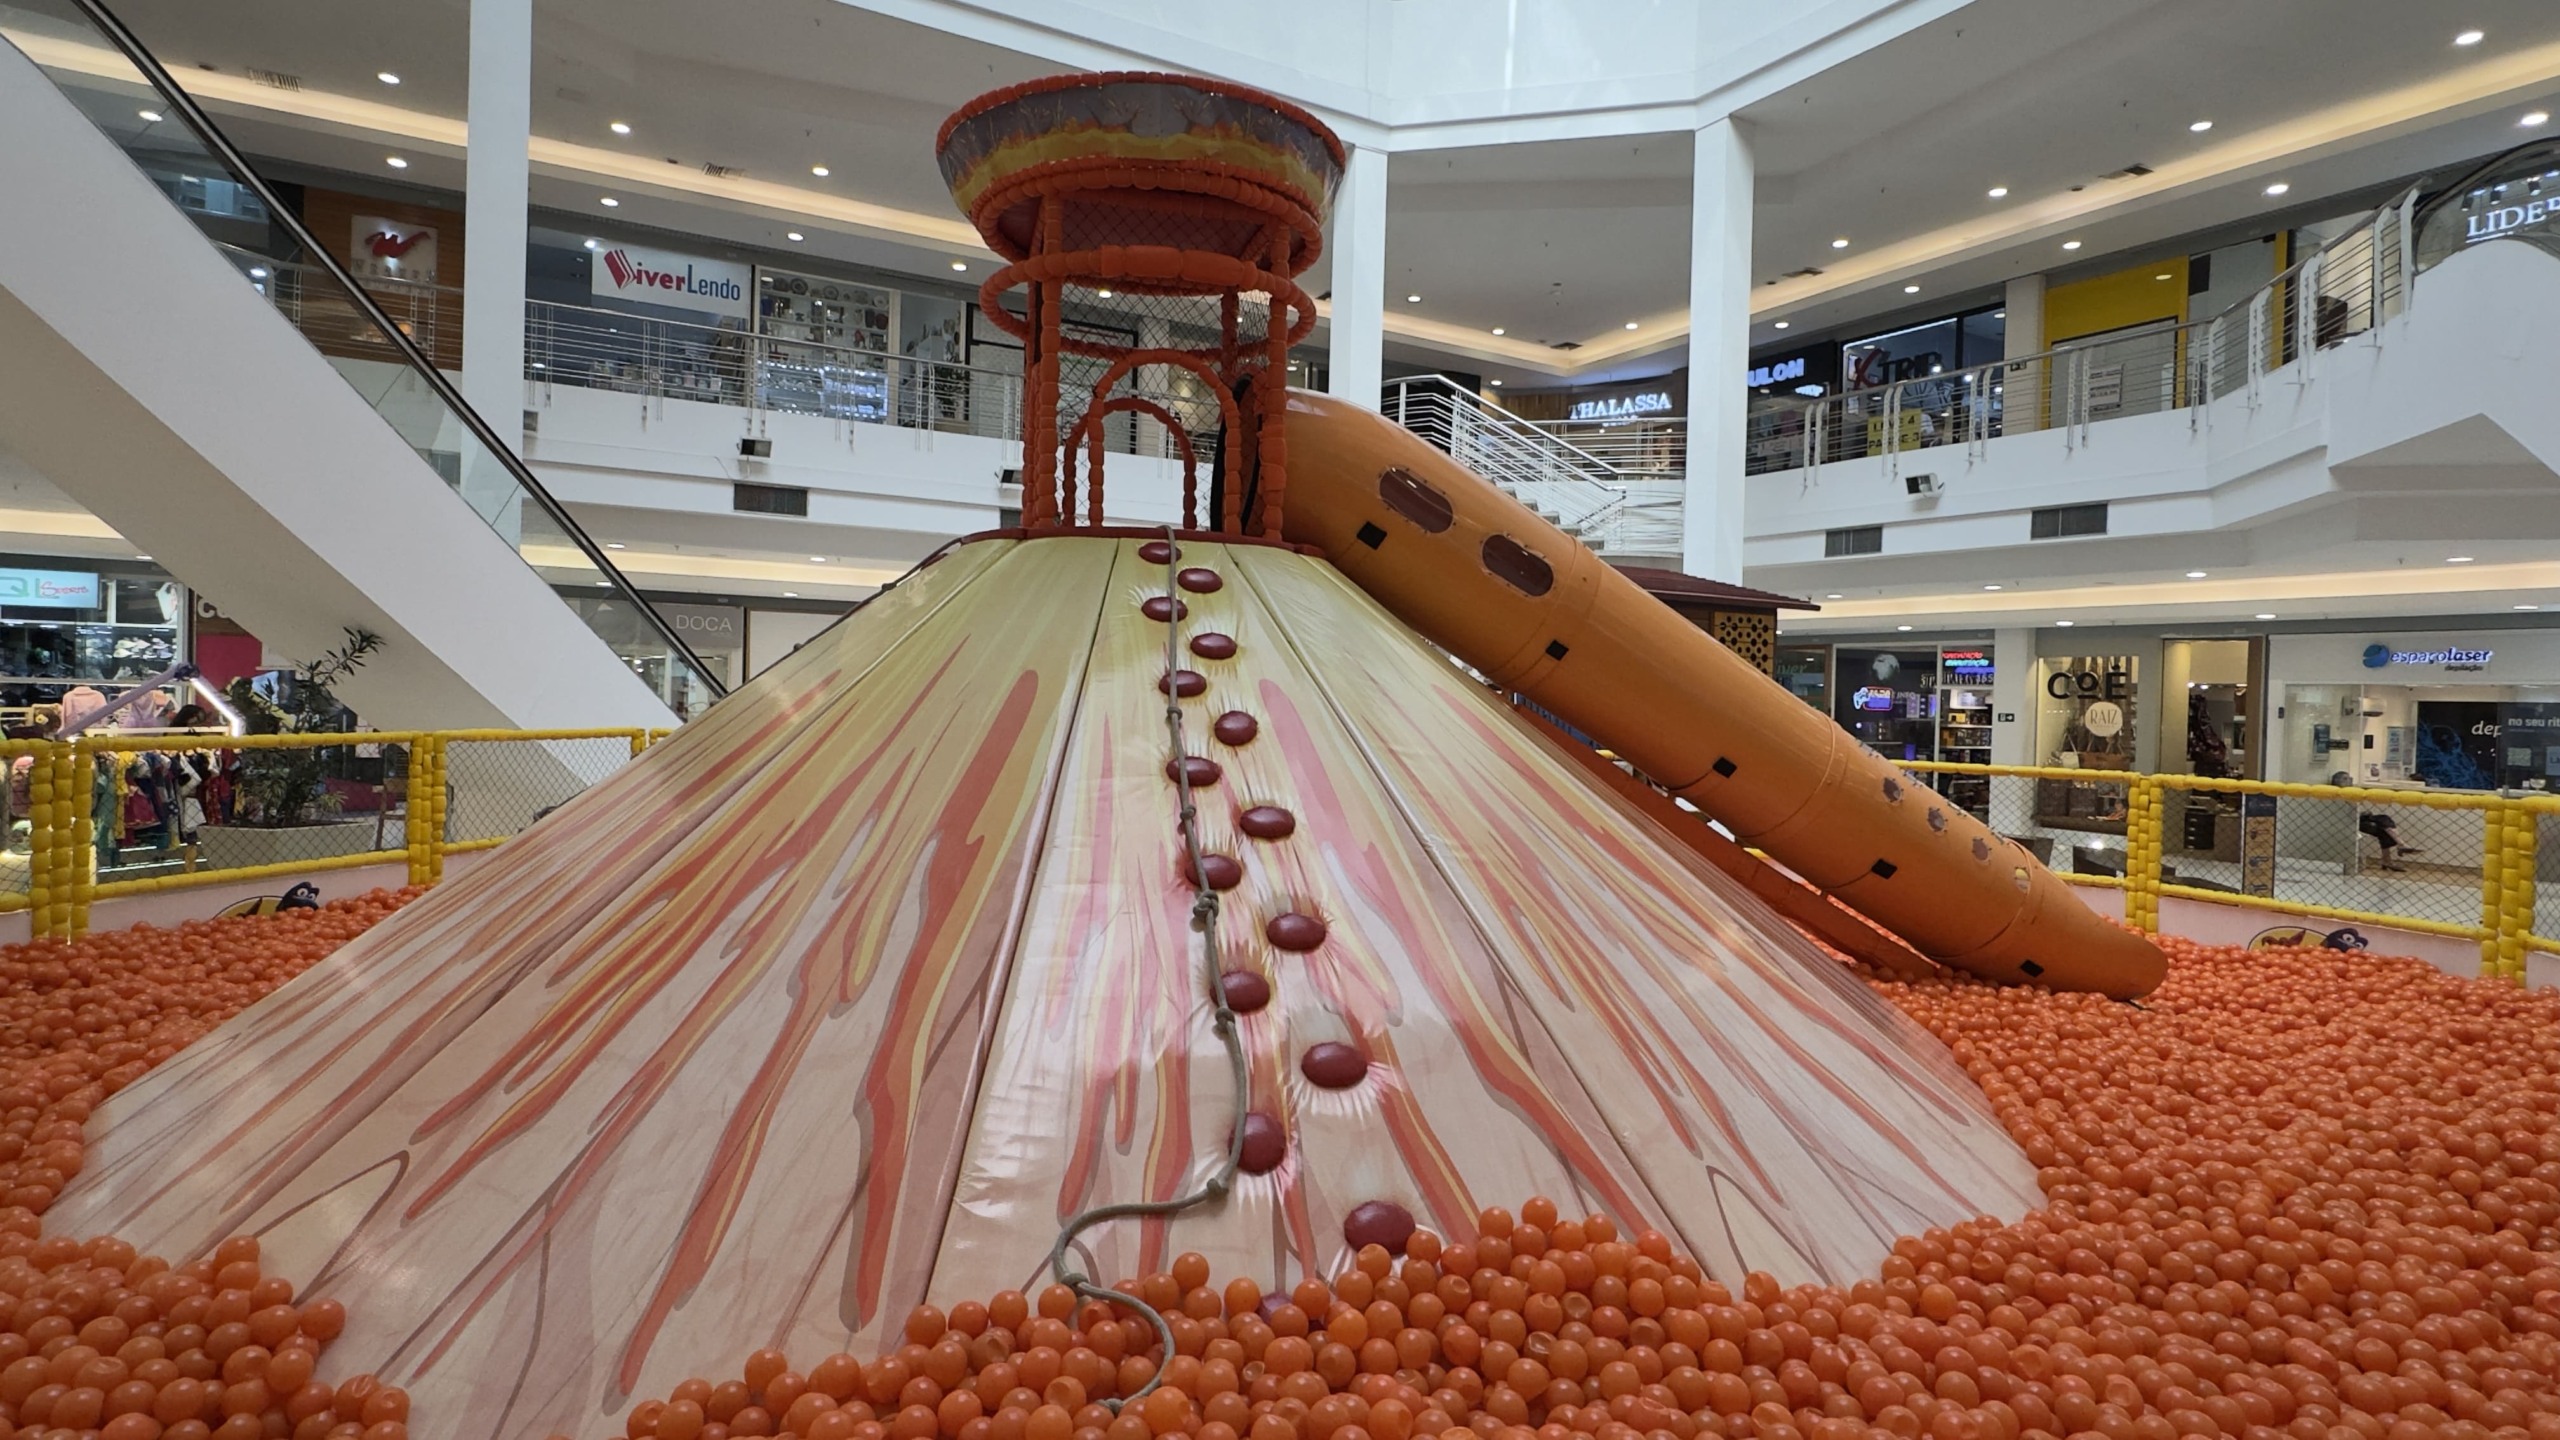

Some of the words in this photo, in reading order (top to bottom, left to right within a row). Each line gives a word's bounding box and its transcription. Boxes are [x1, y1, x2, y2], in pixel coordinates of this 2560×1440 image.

[1568, 392, 1673, 420] THALASSA
[675, 614, 733, 632] DOCA
[2390, 646, 2493, 665] espaçolaser
[2090, 709, 2118, 725] RAIZ
[2508, 718, 2523, 727] no
[2525, 718, 2545, 727] seu
